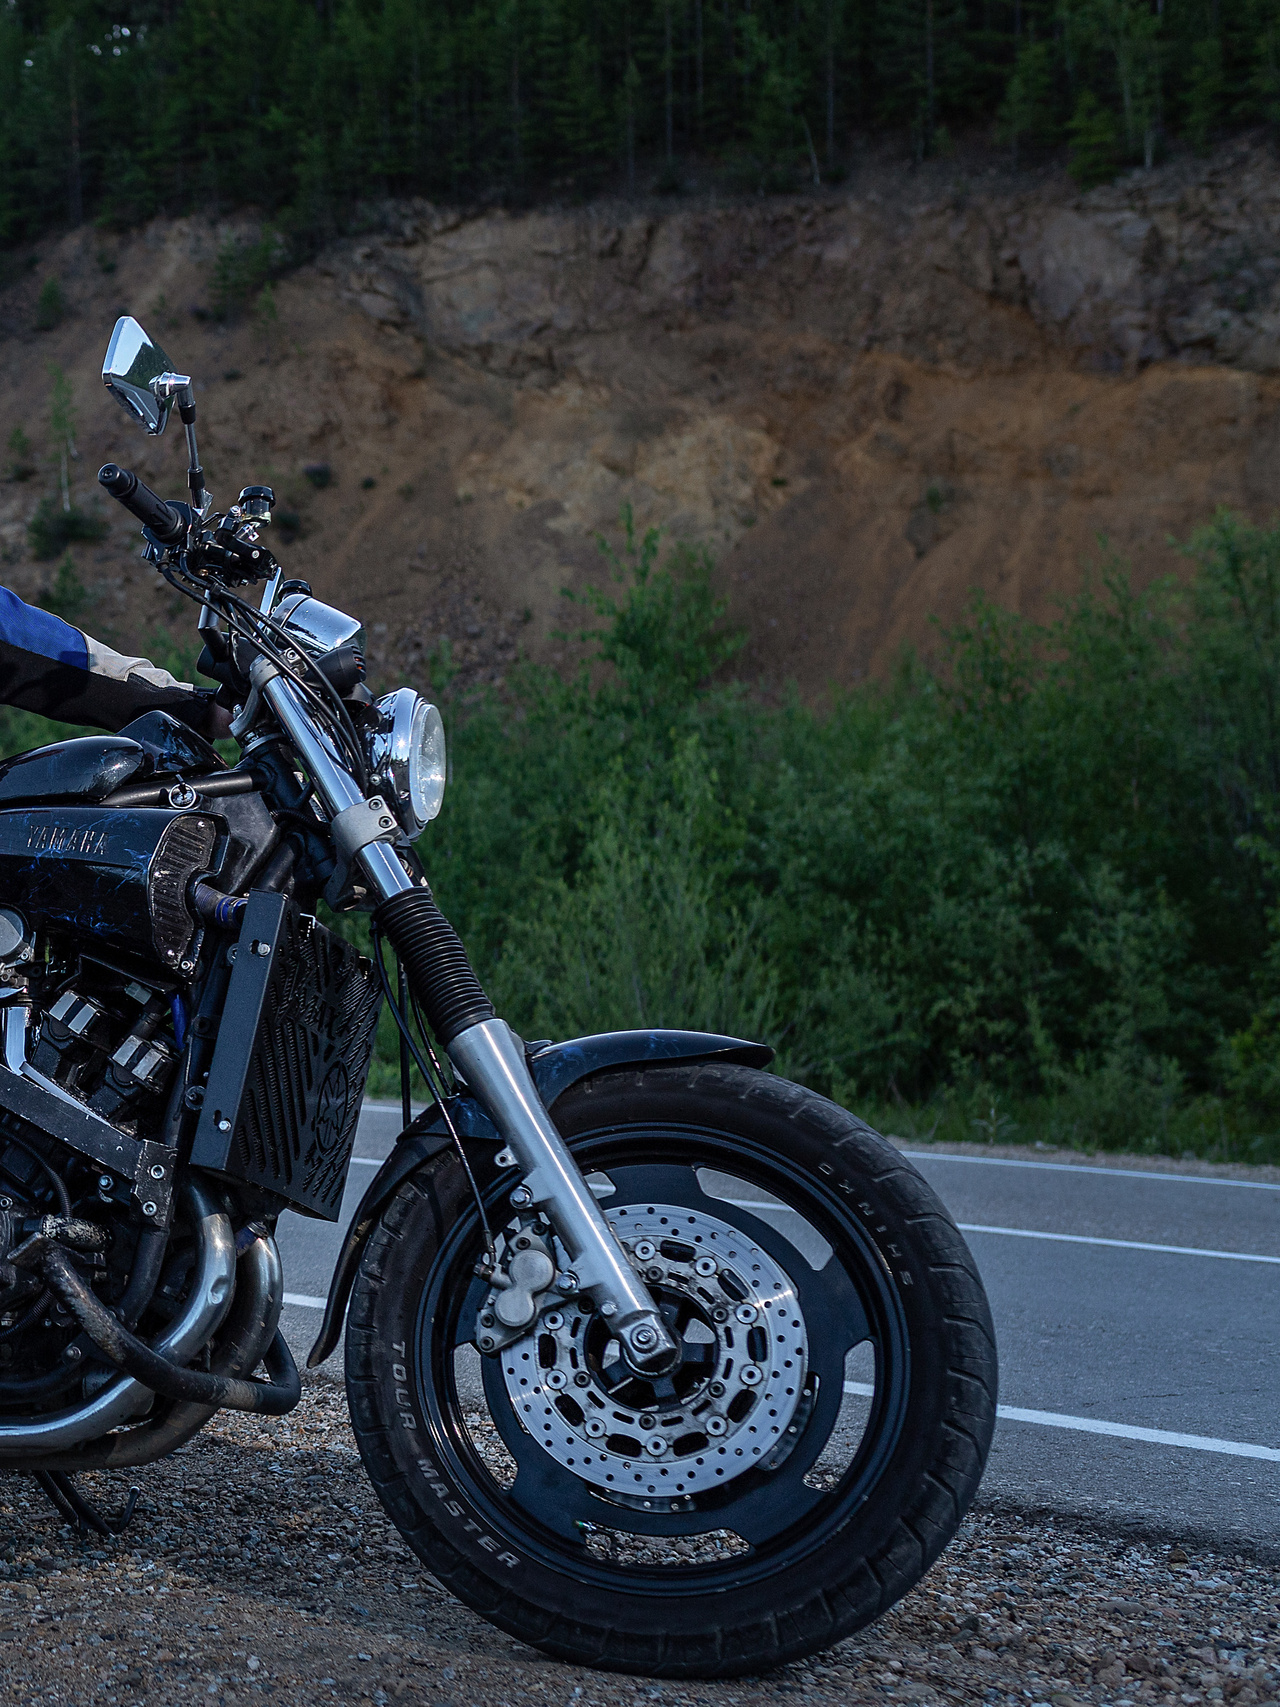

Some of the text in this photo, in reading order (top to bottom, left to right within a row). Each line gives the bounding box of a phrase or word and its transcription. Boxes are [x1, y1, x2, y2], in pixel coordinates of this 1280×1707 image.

[26, 825, 109, 855] YAMAHA
[391, 1340, 521, 1569] TOUR MASTER
